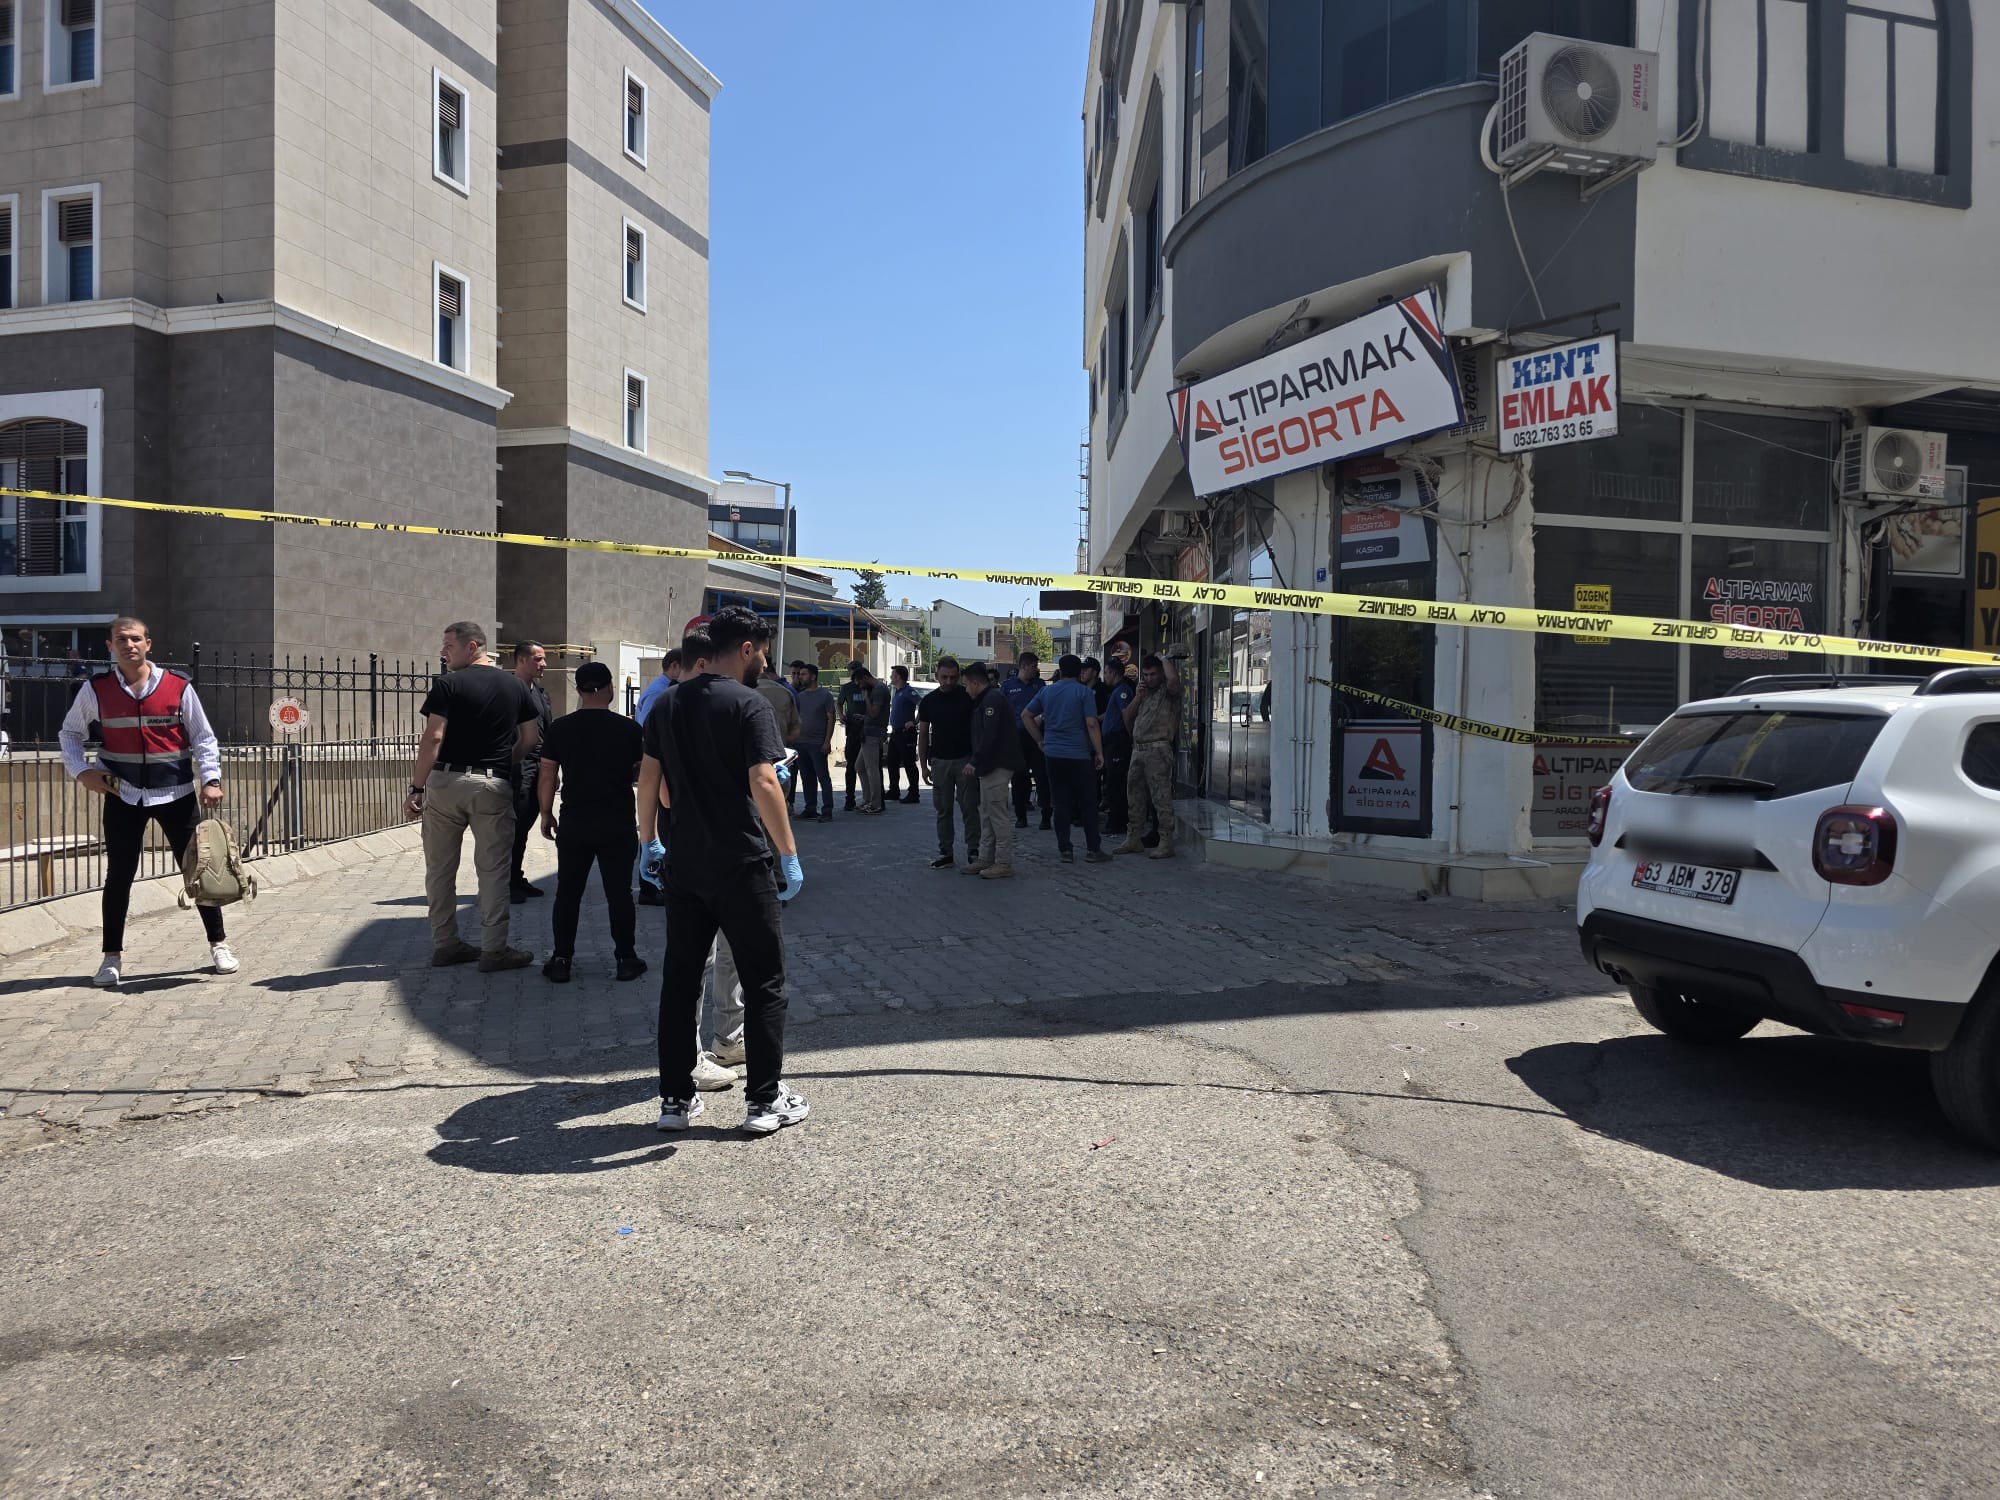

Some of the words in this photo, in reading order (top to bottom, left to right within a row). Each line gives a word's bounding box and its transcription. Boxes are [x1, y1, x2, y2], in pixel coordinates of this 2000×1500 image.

[1633, 63, 1642, 97] ALTUS
[1512, 343, 1600, 389] KENT
[1195, 326, 1416, 442] ALTIPARMAK
[1503, 375, 1612, 430] EMLAK
[1219, 388, 1405, 475] SİGORTA
[1513, 427, 1561, 447] 0532.763
[1563, 422, 1576, 439] 33
[1579, 420, 1593, 436] 65
[1355, 545, 1384, 555] KASKO
[986, 574, 1054, 587] JANDARMA
[1087, 579, 1143, 593] GİRİLMEZ
[1153, 583, 1181, 597] YERİ
[1192, 586, 1226, 600] OLAY
[1577, 587, 1609, 605] ÖZGENÇ
[1704, 577, 1812, 602] ALTIPARMAK
[1254, 591, 1324, 609] JANDARMA
[1358, 599, 1417, 616] GİRİLMEZ
[1427, 605, 1457, 620] YERİ
[1470, 609, 1506, 623] OLAY
[1711, 600, 1805, 630] SİGORTA
[1537, 614, 1613, 632] JANDARMA
[1651, 623, 1718, 639] GİRİLMEZ
[1779, 633, 1821, 647] OLAY
[1459, 720, 1500, 737] POLİS
[1347, 785, 1417, 797] ALTIPARMAK
[1644, 863, 1662, 882] 63
[1666, 865, 1696, 889] ABM
[1702, 870, 1733, 895] 378
